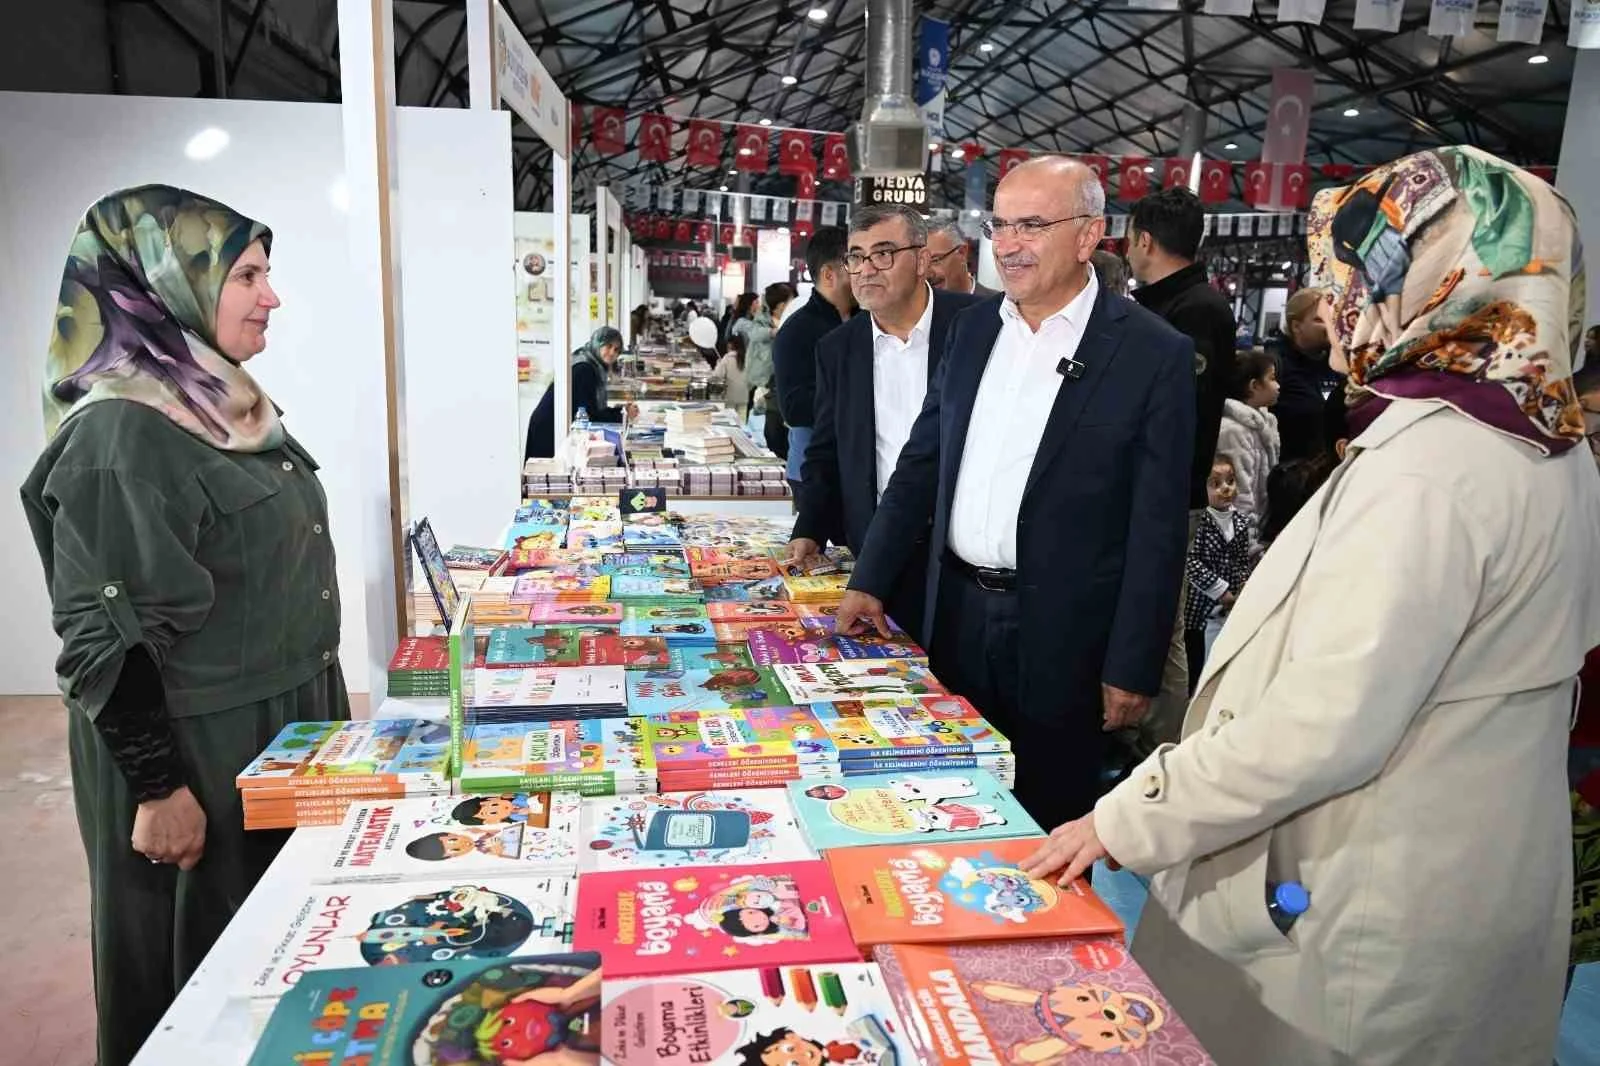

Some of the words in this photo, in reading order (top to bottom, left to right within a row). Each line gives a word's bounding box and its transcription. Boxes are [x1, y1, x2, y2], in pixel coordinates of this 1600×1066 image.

[873, 190, 926, 204] GRUBU
[874, 176, 925, 189] MEDYA
[530, 732, 549, 761] SAYILARI
[348, 805, 394, 867] MATEMATİK
[635, 881, 683, 956] boyama
[888, 858, 945, 926] boyama
[282, 895, 352, 985] OYUNLAR
[254, 967, 275, 987] Zeka
[614, 1040, 627, 1059] Zeka
[656, 1000, 686, 1058] Boyama
[682, 986, 711, 1063] Etkinlikleri
